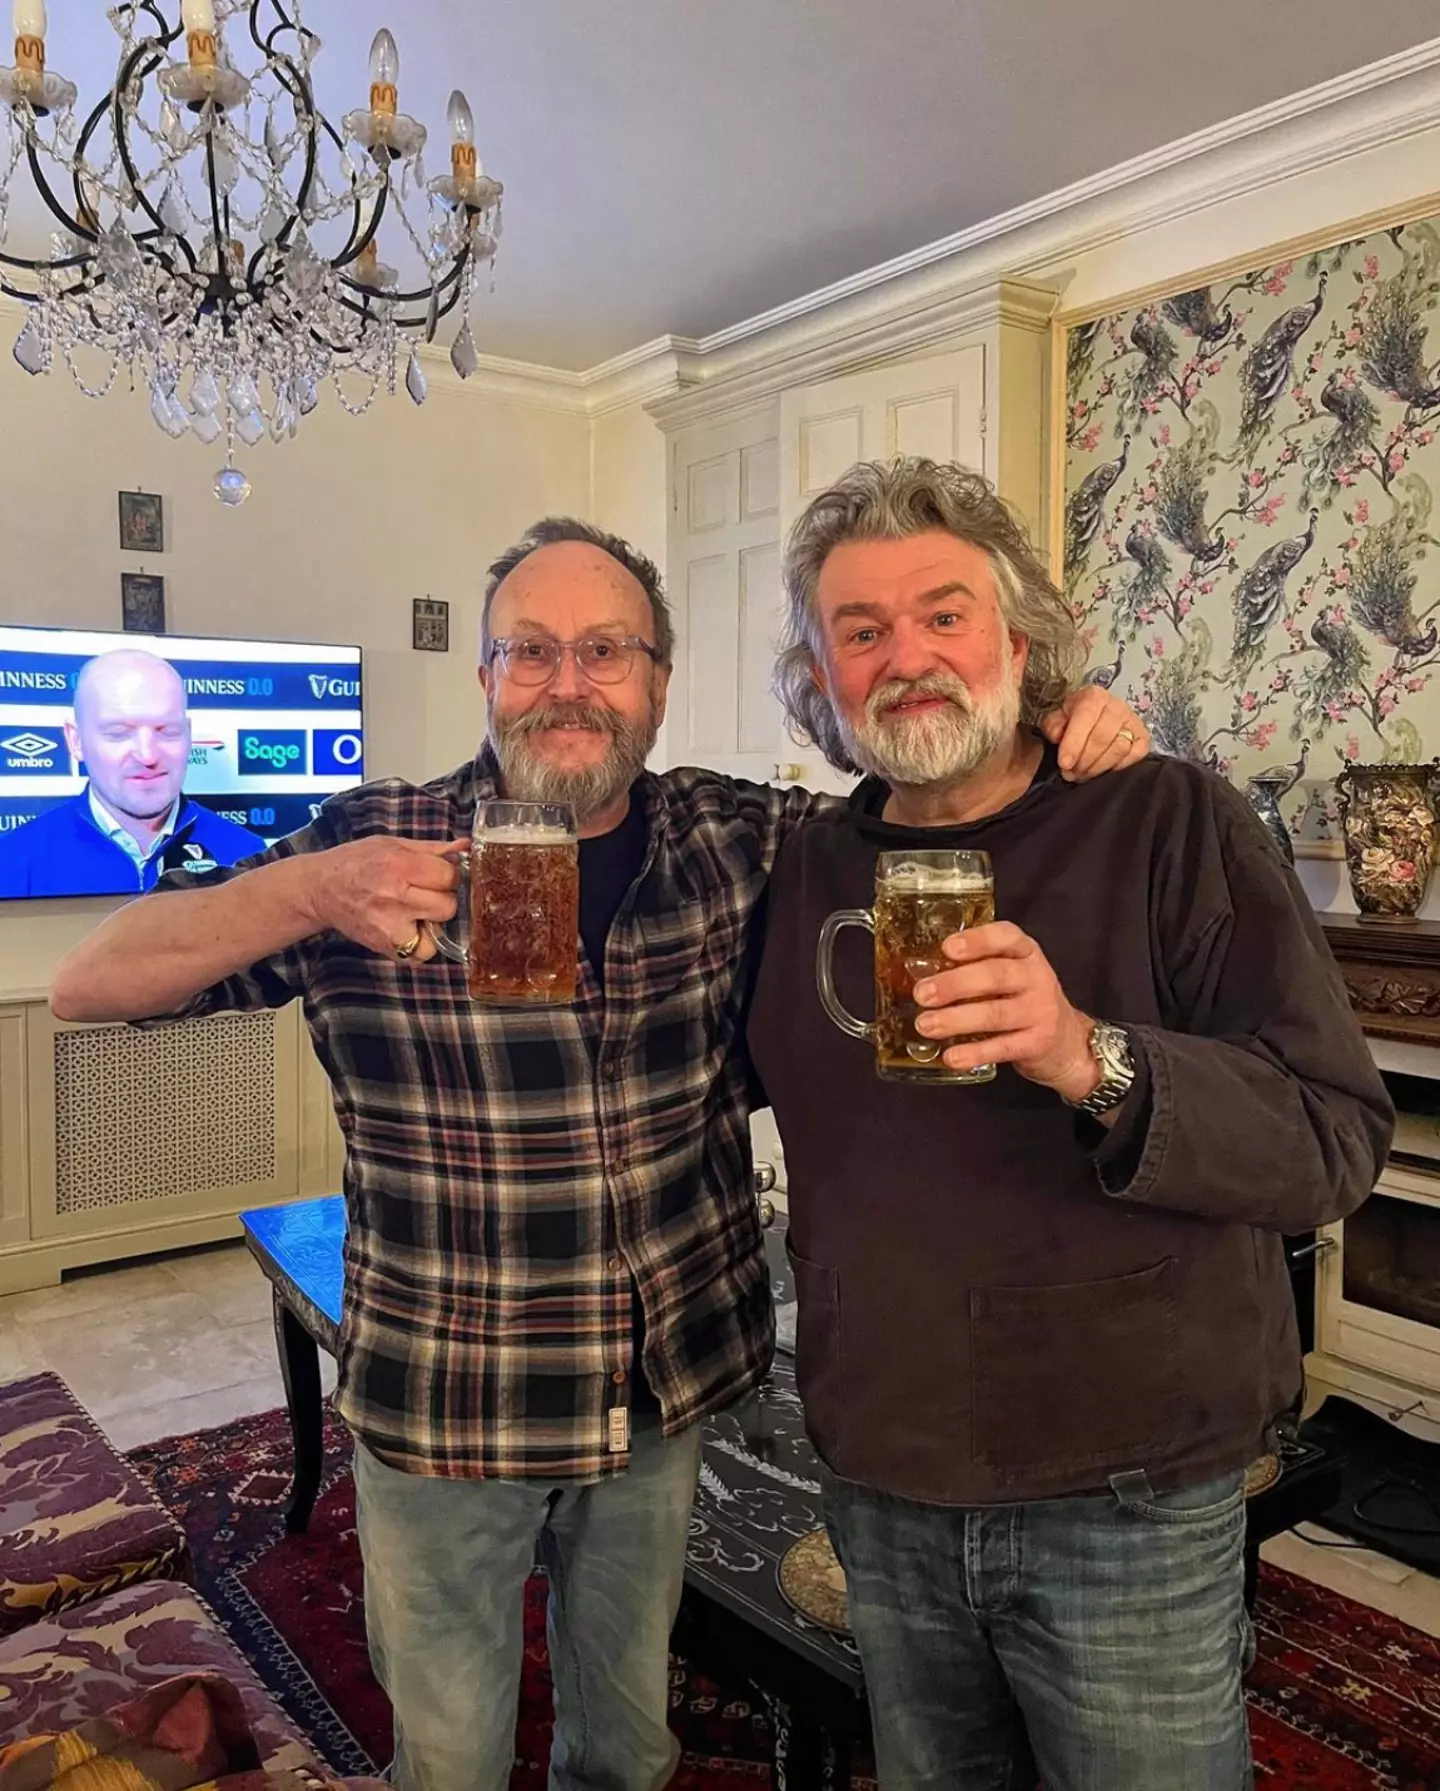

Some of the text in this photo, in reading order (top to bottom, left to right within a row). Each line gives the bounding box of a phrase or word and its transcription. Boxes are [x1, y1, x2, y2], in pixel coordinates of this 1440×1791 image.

[183, 677, 273, 696] INNESS 0.0
[244, 736, 300, 768] Sage
[7, 756, 54, 768] umbro
[250, 807, 275, 826] 0.0
